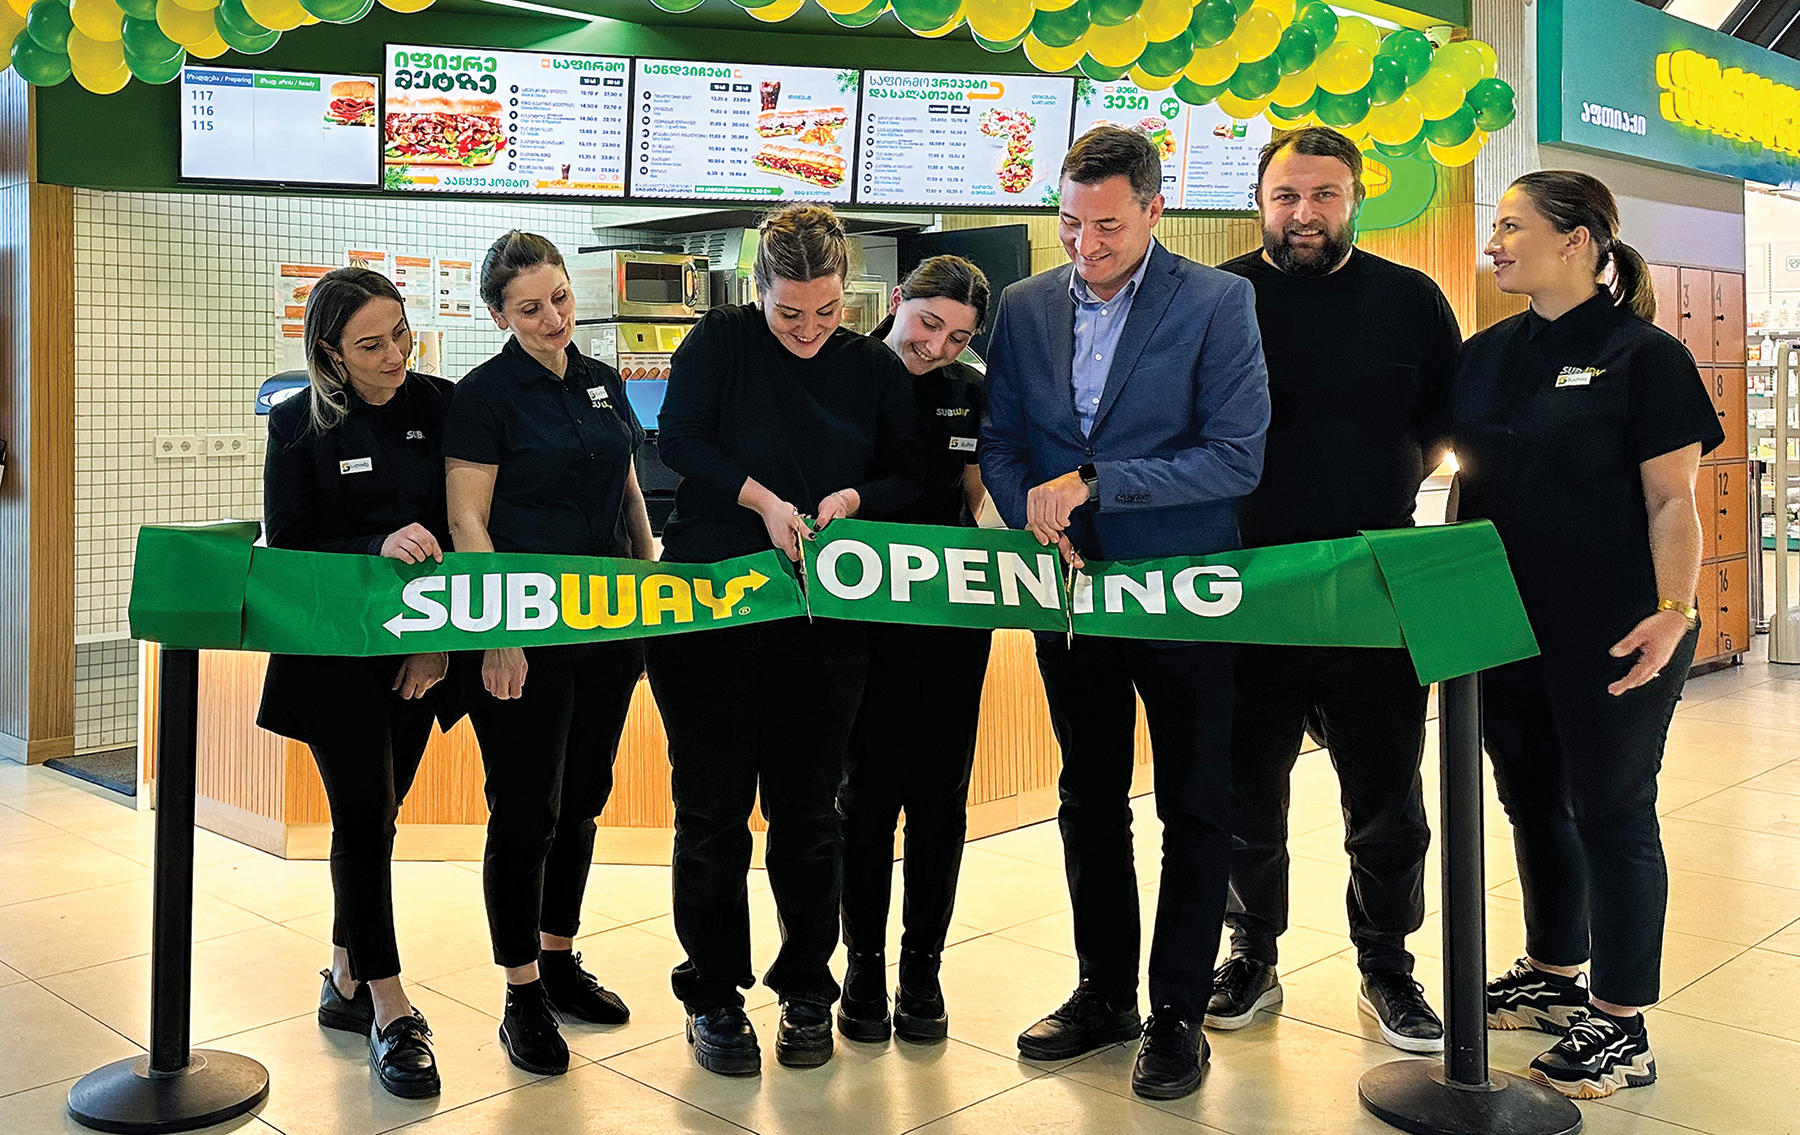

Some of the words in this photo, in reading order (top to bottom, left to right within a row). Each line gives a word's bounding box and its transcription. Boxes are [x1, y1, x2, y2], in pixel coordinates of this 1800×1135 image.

[395, 51, 497, 72] იფიქრე
[553, 59, 625, 72] საფირმო
[644, 64, 731, 78] სენდვიჩები
[395, 70, 497, 94] მეტზე
[869, 76, 929, 88] საფირმო
[191, 90, 213, 101] 117
[869, 88, 888, 98] და
[890, 89, 963, 100] სალათები
[191, 105, 214, 116] 116
[1581, 101, 1647, 136] აფთიაქი
[191, 120, 214, 131] 115
[1683, 284, 1690, 308] 3
[1715, 284, 1722, 308] 4
[1717, 374, 1723, 398] 8
[1718, 472, 1729, 496] 12
[816, 538, 1243, 618] OPENING
[1719, 568, 1729, 593] 16
[382, 568, 771, 640] SUBWAY
